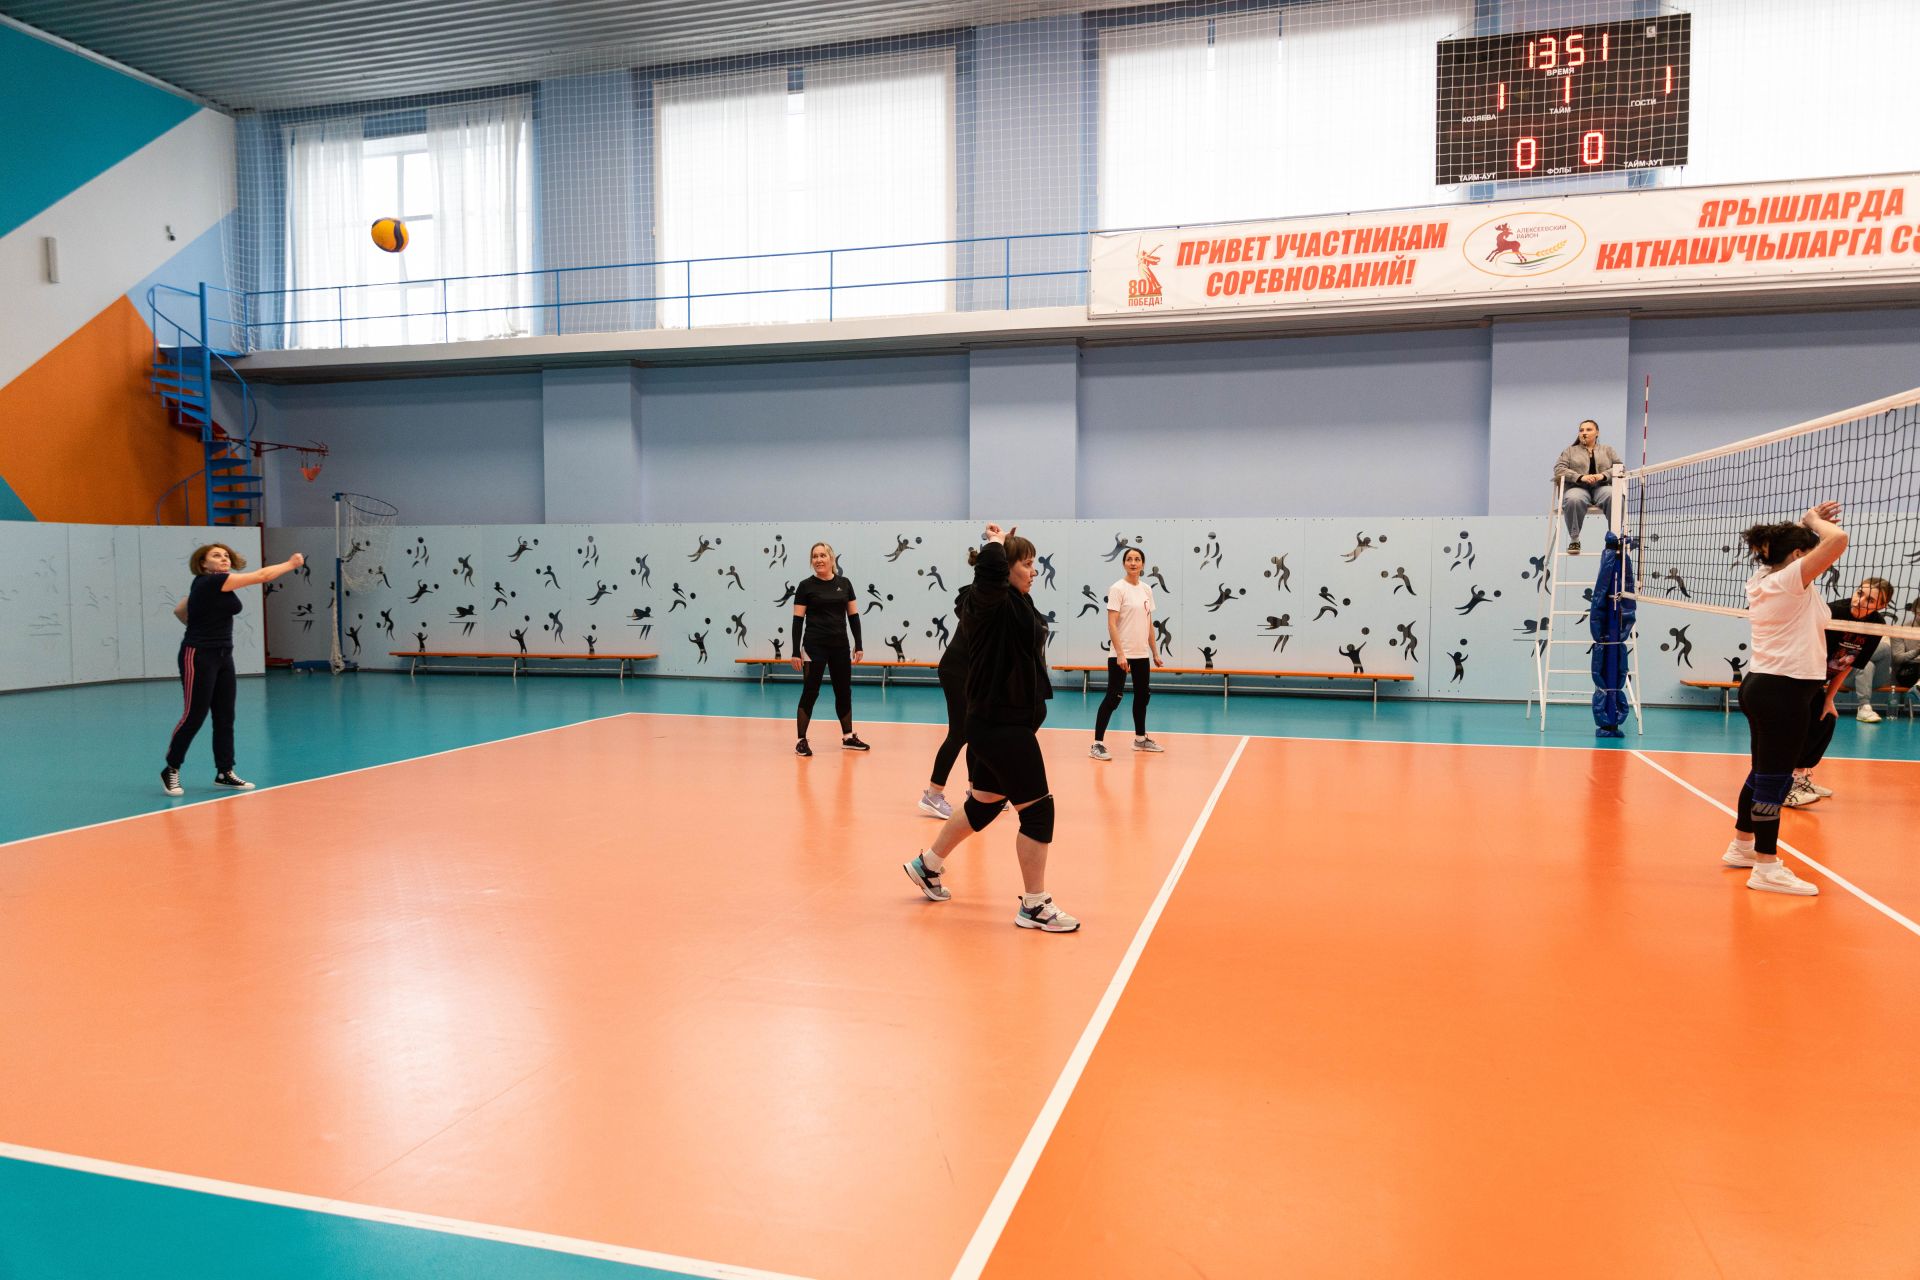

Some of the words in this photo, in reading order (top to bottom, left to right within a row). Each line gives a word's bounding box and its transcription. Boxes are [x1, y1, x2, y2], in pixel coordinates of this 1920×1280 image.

[1546, 67, 1575, 76] ВРЕМЯ
[1665, 65, 1672, 94] 1
[1565, 76, 1571, 104] 1
[1549, 106, 1571, 115] ТАЙМ
[1630, 98, 1657, 107] ГОСТИ
[1517, 138, 1536, 169] 0
[1583, 132, 1603, 164] 0
[1546, 166, 1572, 175] ФОЛЫ
[1623, 158, 1663, 168] ТАЙМ-АУТ
[1459, 172, 1497, 182] ТАЙМ-АУТ
[1697, 188, 1904, 229] ЯРЫШЛАРДА
[1176, 235, 1271, 267] ПРИВЕТ
[1273, 222, 1449, 260] УЧАСТНИКАМ
[1595, 227, 1883, 271] КАТНАШУЧЫЛАРГА
[1206, 254, 1417, 298] СОРЕВНОВАНИЙ!
[1129, 278, 1148, 296] 80
[1128, 296, 1163, 306] ПОБЕДА!
[1752, 802, 1779, 815] NIK
